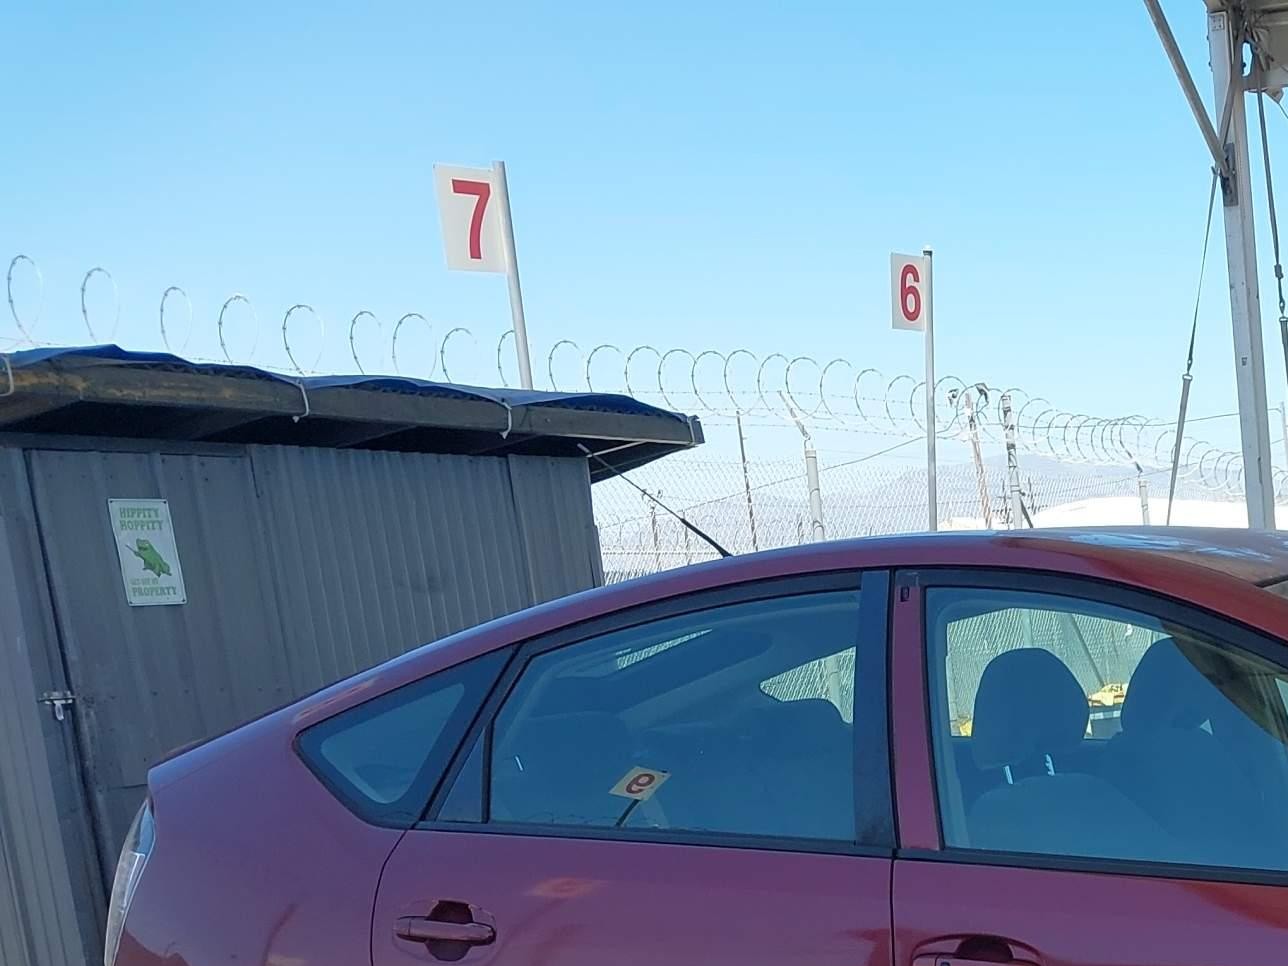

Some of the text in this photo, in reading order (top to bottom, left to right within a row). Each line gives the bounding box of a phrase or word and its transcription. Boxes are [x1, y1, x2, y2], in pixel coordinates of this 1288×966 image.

[451, 179, 491, 260] 7
[900, 264, 921, 322] 6
[119, 507, 159, 519] HIPPITY
[119, 519, 164, 531] HOPPITY
[131, 586, 177, 598] PROPERTY
